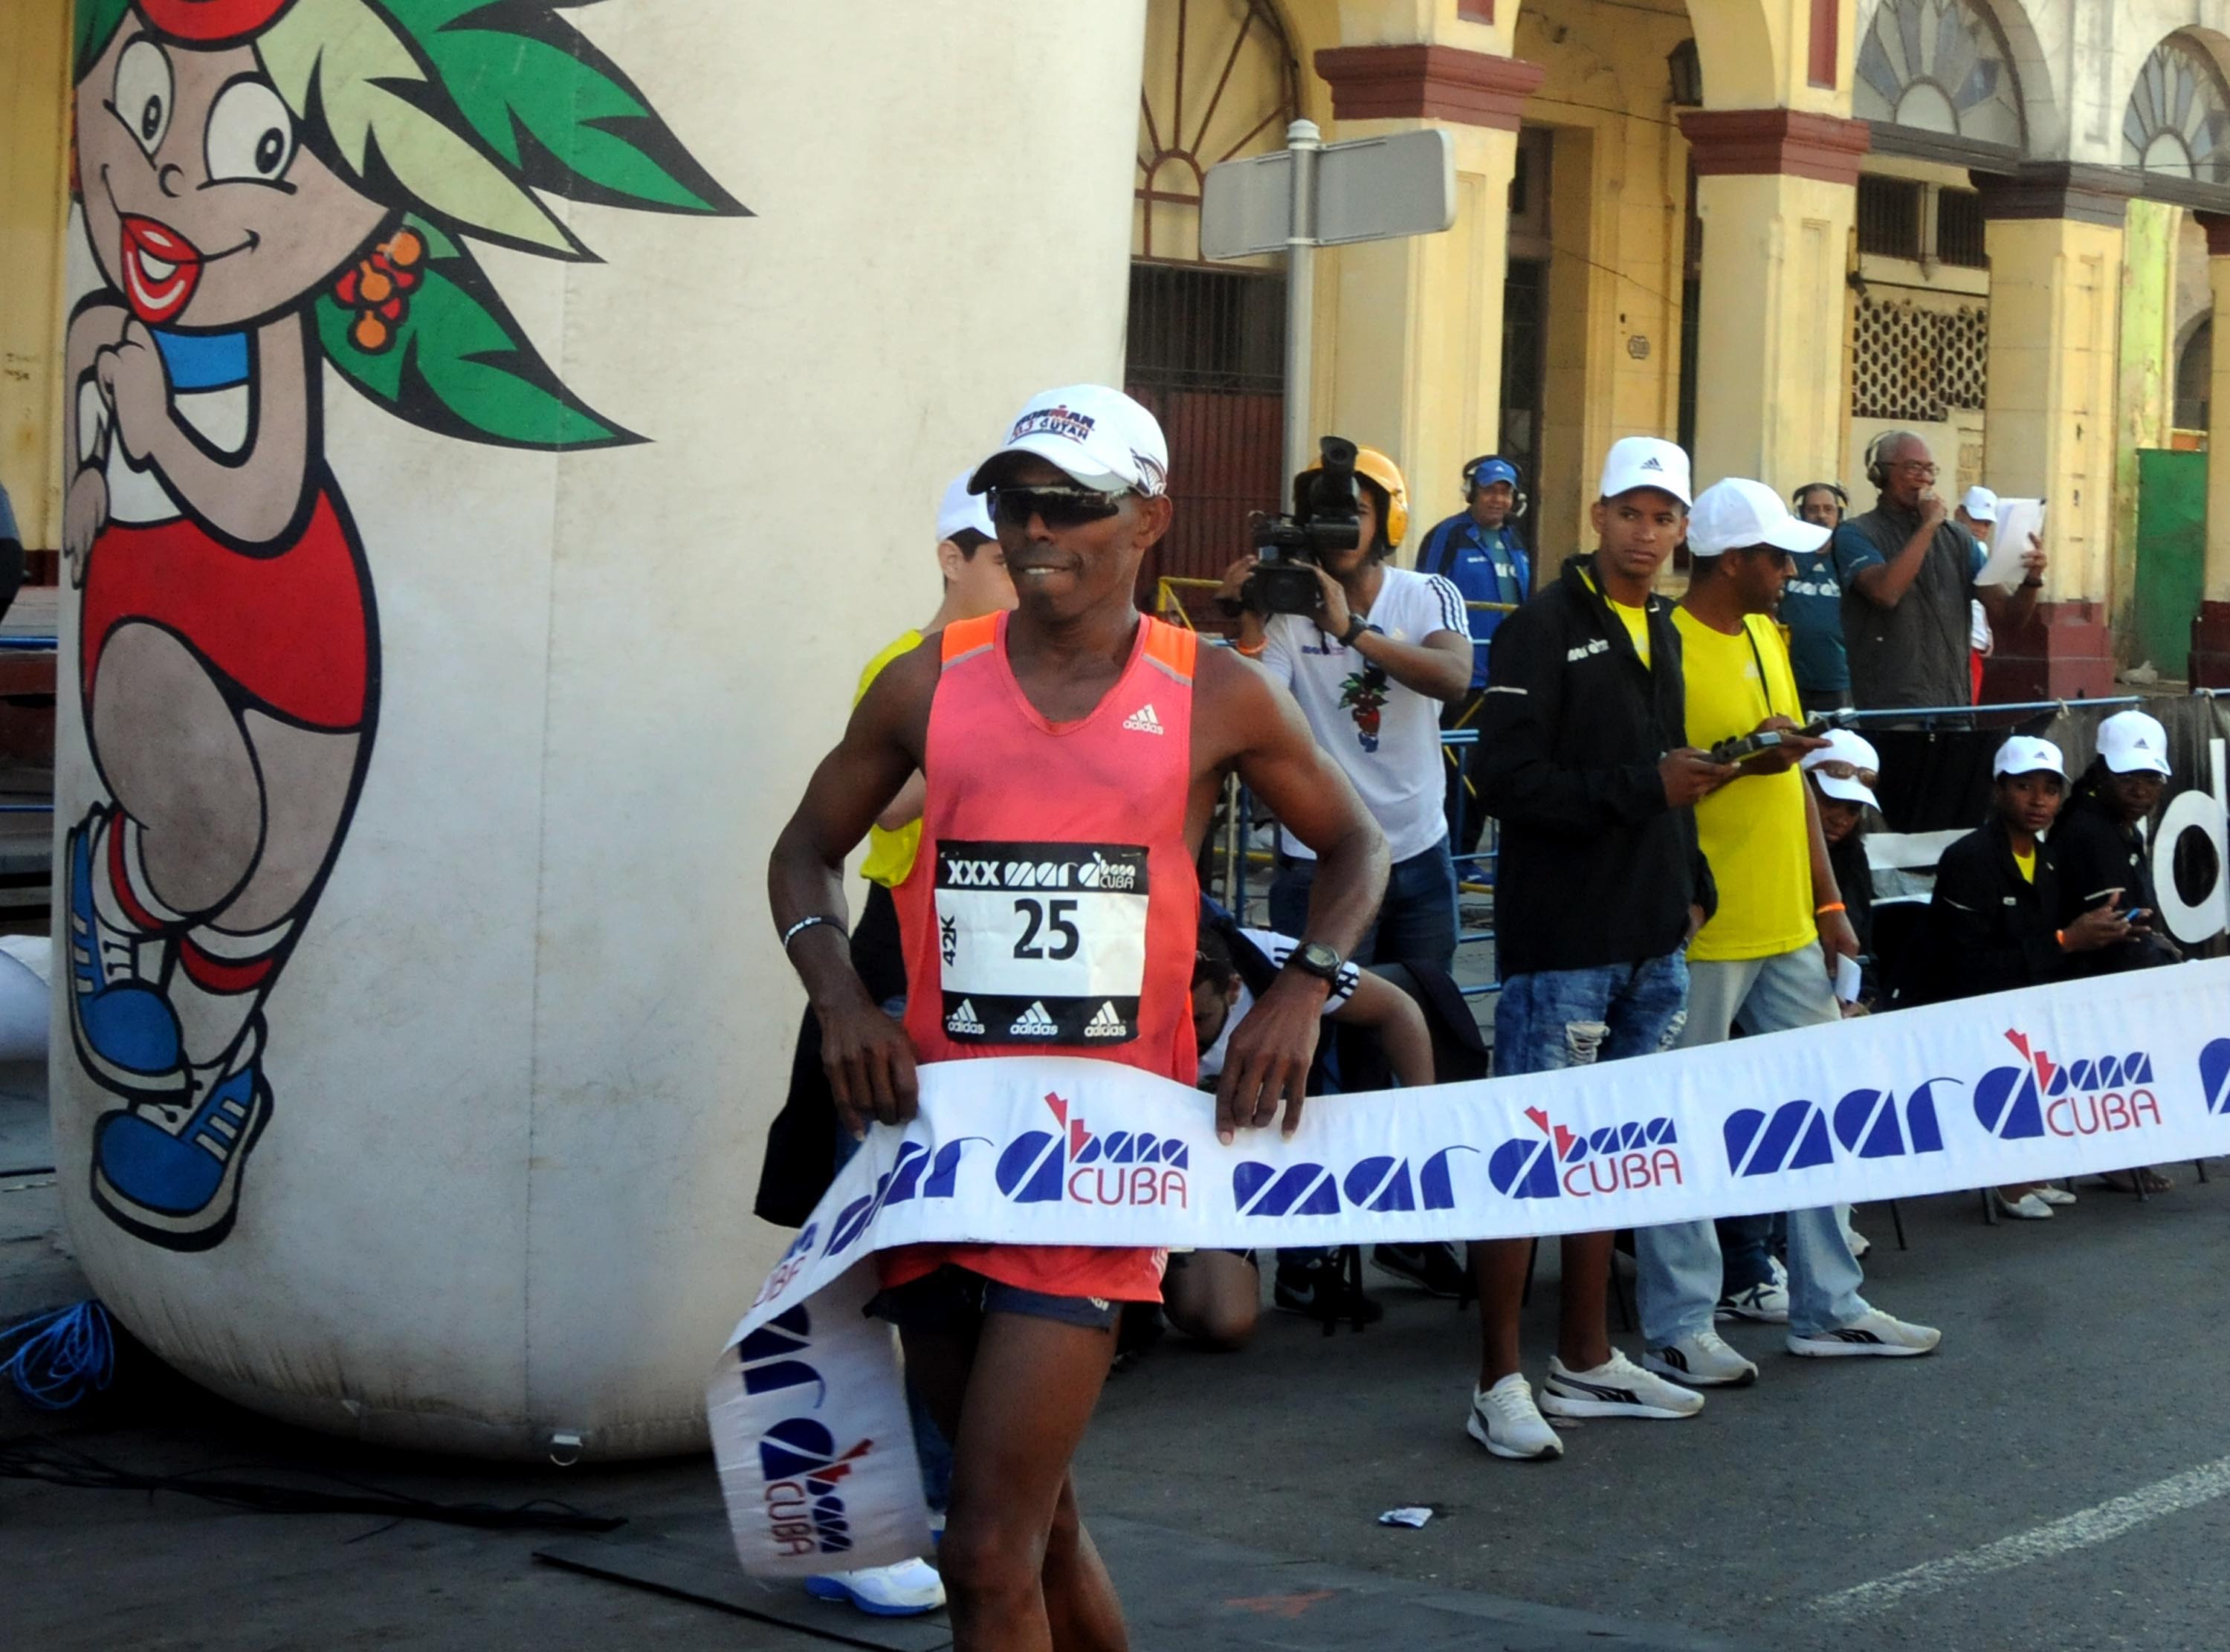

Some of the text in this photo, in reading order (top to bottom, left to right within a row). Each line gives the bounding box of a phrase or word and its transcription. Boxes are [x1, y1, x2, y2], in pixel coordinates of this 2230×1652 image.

[947, 860, 1001, 886] XXX
[1099, 875, 1135, 890] CUBA
[940, 915, 957, 967] 42K
[1013, 898, 1080, 961] 25
[948, 1020, 1127, 1037] adidas adidas adidas
[2047, 1089, 2162, 1137] CUBA
[1068, 1166, 1187, 1209] CUBA
[1562, 1148, 1683, 1197] CUBA
[764, 1481, 816, 1557] CUBA
